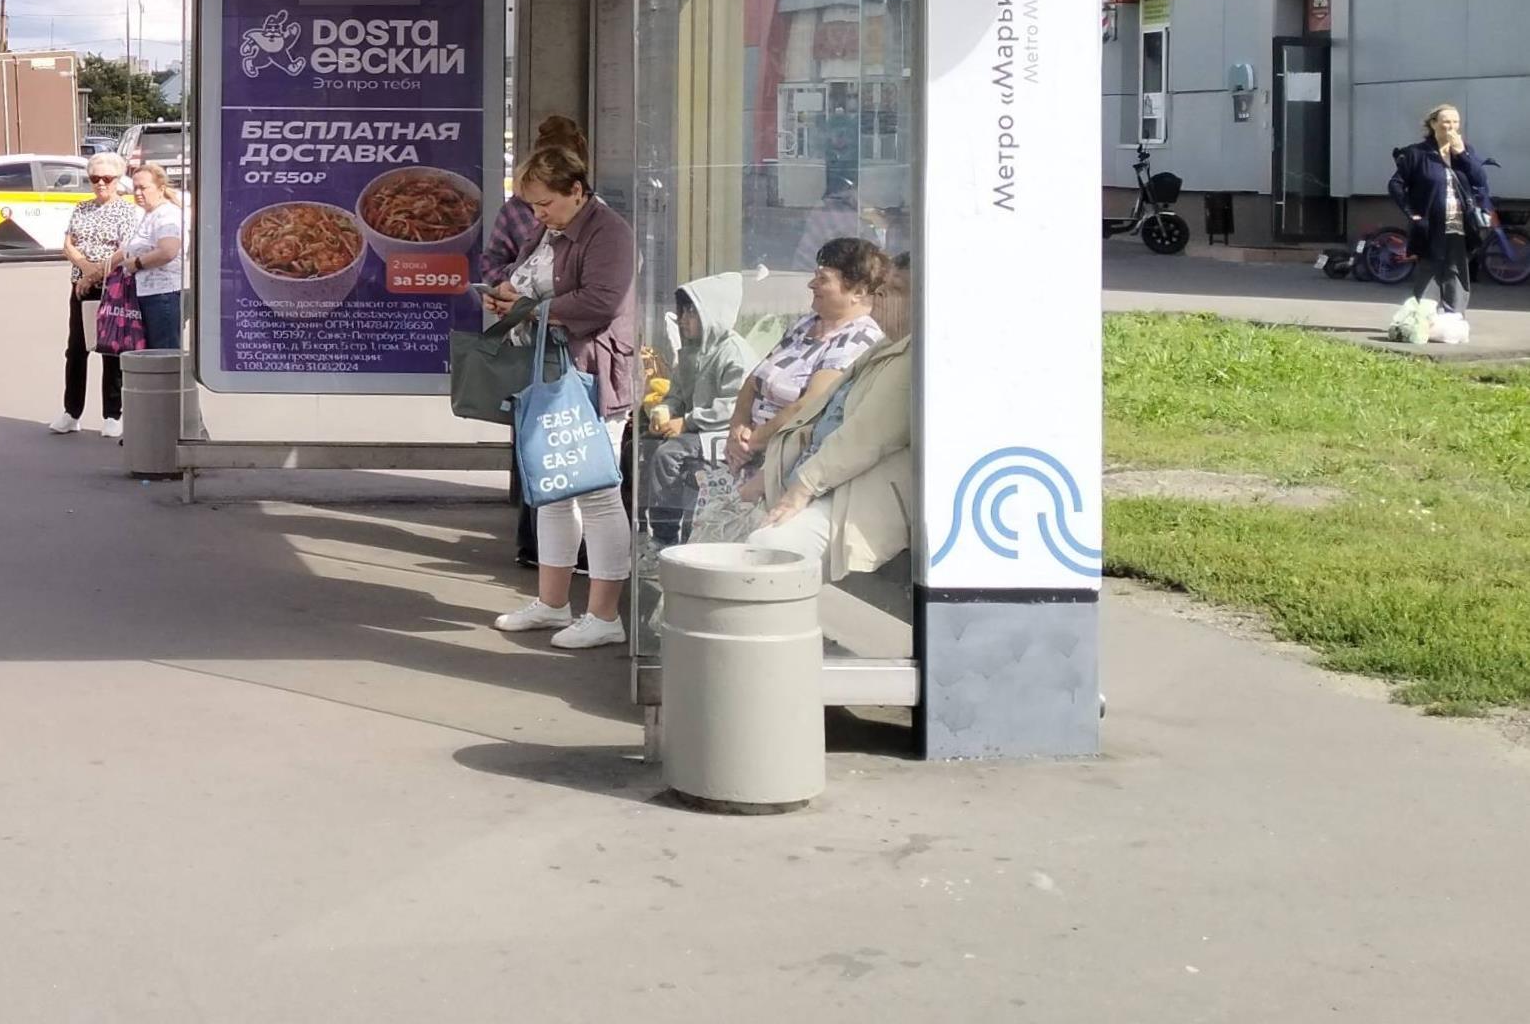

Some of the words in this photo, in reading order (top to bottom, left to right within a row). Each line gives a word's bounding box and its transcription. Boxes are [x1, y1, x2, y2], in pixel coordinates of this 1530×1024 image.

[1023, 24, 1040, 85] Metro
[313, 77, 343, 89] Это
[347, 79, 378, 92] про
[382, 78, 421, 89] тебя
[241, 121, 461, 141] БЕСПЛАТНАЯ
[239, 143, 419, 166] ДОСТАВКА
[992, 113, 1020, 213] Метро
[244, 171, 272, 184] ОТ
[393, 260, 400, 269] 2
[393, 276, 412, 286] за
[387, 301, 398, 309] от
[423, 310, 448, 319] ООО
[442, 360, 452, 373] 1
[542, 446, 588, 470] EASY
